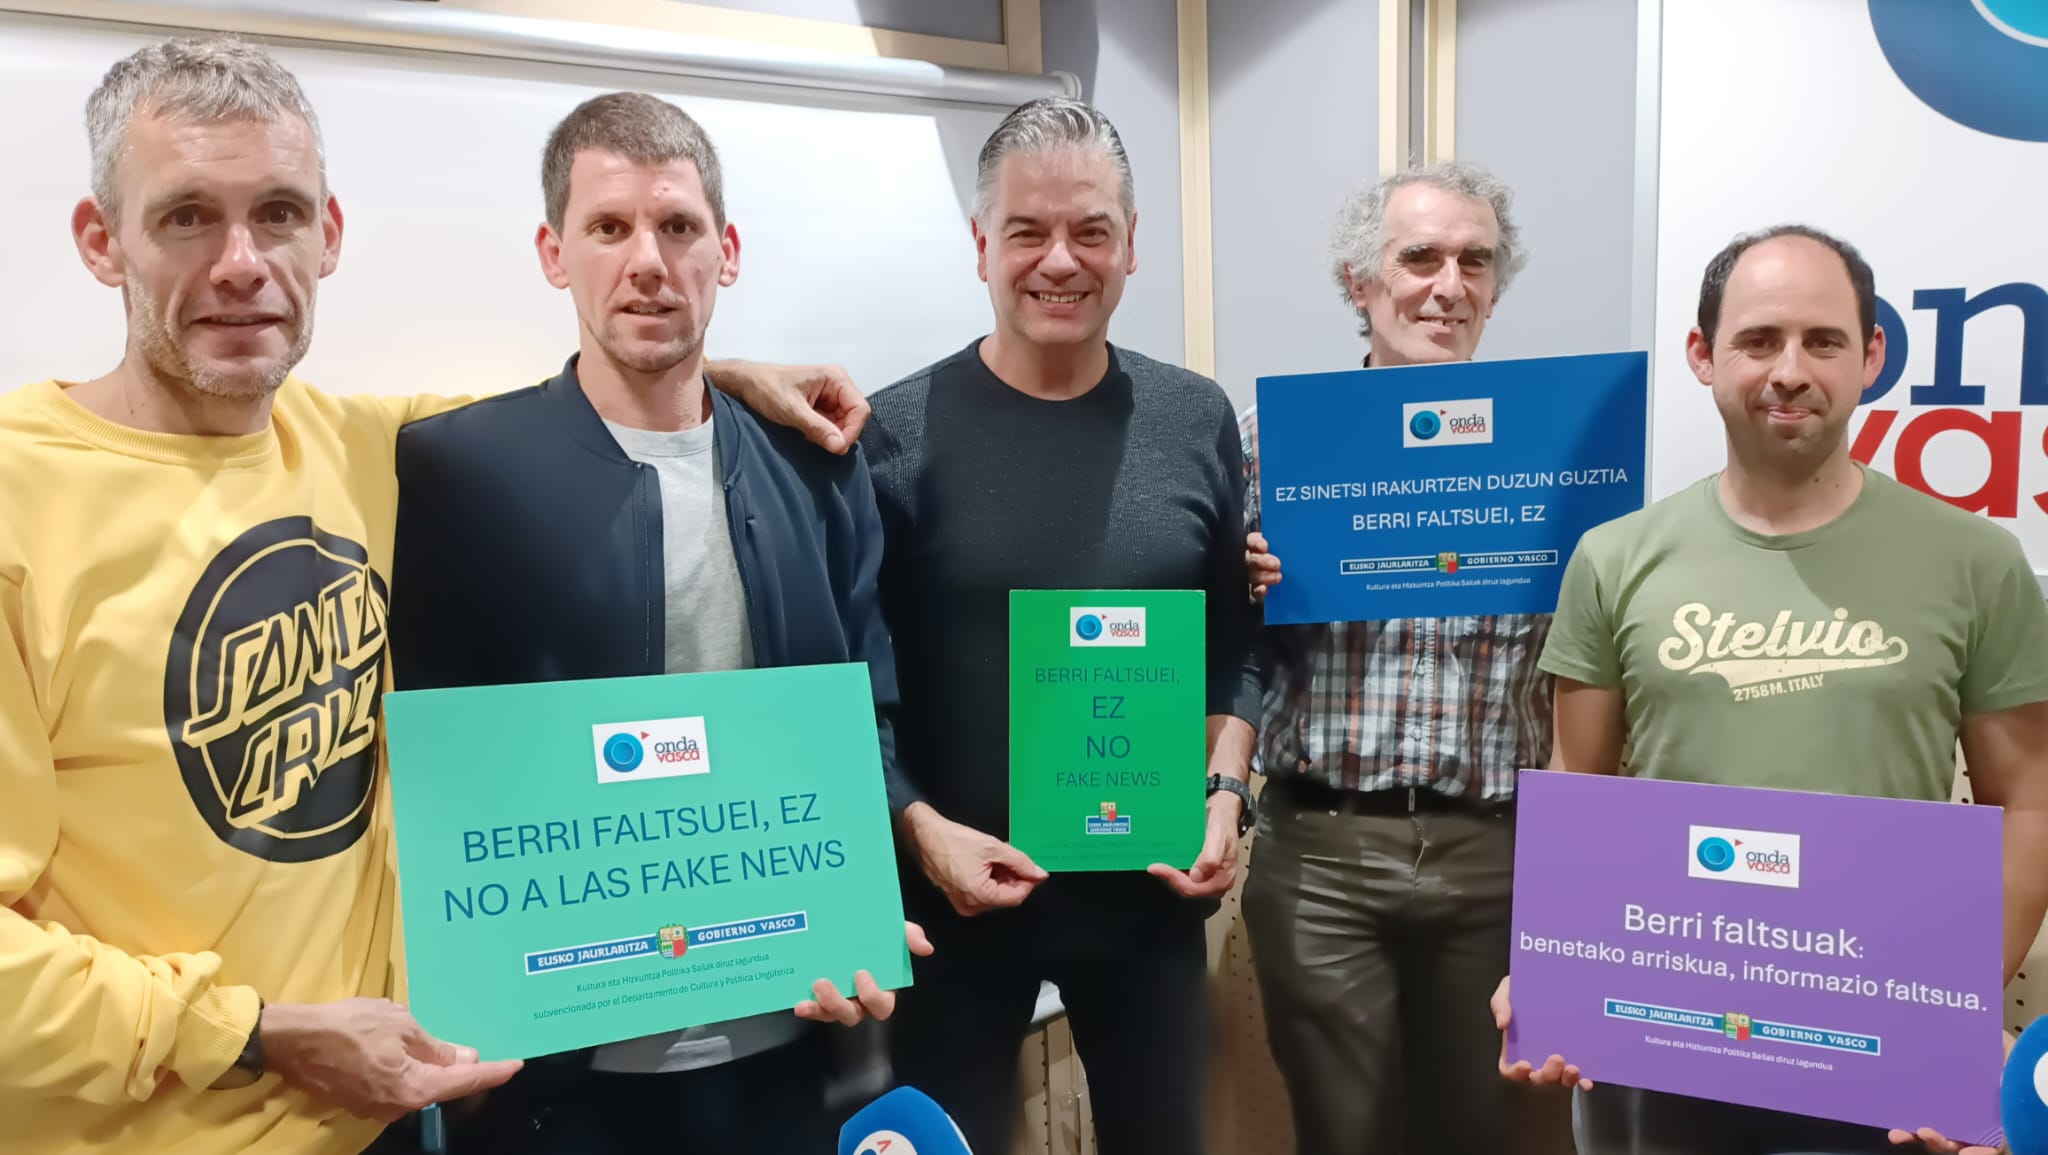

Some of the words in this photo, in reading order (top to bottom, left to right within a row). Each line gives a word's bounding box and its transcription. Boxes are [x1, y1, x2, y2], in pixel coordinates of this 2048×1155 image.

[1450, 413, 1485, 427] onda
[1451, 424, 1486, 434] vasca
[1276, 487, 1297, 502] EZ
[1300, 482, 1367, 500] SINETSI
[1372, 476, 1482, 496] IRAKURTZEN
[1487, 472, 1553, 490] DUZUN
[1559, 468, 1628, 486] GUZTIA
[1353, 512, 1411, 531] BERRI
[1417, 506, 1515, 527] FALTSUEI,
[1521, 505, 1546, 522] EZ
[1349, 562, 1375, 571] EUSKO
[1377, 559, 1429, 570] JAURLARITZA
[1467, 556, 1514, 565] GOBIERNO
[1518, 554, 1548, 563] VASCO
[1109, 619, 1139, 631] onda
[1110, 629, 1140, 637] vasca
[1657, 602, 1895, 671] Stelvio
[1035, 667, 1088, 683] BERRI
[1093, 667, 1181, 685] FALTSUEI,
[1789, 674, 1824, 693] ITALY
[1092, 696, 1125, 719] EZ
[654, 736, 698, 754] onda
[656, 748, 700, 764] vasca
[1086, 735, 1130, 759] NO
[1056, 772, 1100, 787] FAKE
[1106, 771, 1160, 787] NEWS
[463, 819, 581, 863] BERRI
[593, 800, 770, 848] FALTSUEI,
[780, 793, 821, 825] EZ
[1745, 850, 1789, 864] onda
[1747, 861, 1791, 875] vasca
[444, 883, 510, 922] NO
[521, 878, 549, 912] A
[558, 867, 631, 906] LAS
[641, 853, 732, 895] FAKE
[740, 840, 846, 881] NEWS
[537, 953, 574, 967] EUSKO
[577, 941, 649, 963] JAURLARITZA
[697, 924, 756, 942] GOBIERNO
[760, 918, 796, 931] VASCO
[1624, 903, 1702, 940] Berri
[1712, 914, 1864, 959] faltsuak:
[576, 979, 606, 993] Kultura
[607, 979, 621, 988] eta
[661, 966, 691, 978] Politika
[735, 952, 770, 967] lagundua
[1520, 931, 1625, 963] benetako
[1631, 950, 1735, 981] arriskua,
[1743, 960, 1878, 997] informazio
[1885, 978, 1988, 1012] faltsua.
[533, 1000, 597, 1021] subvencionada
[597, 998, 611, 1011] por
[612, 995, 621, 1005] el
[621, 987, 678, 1006] Departamento
[678, 984, 689, 994] de
[690, 979, 719, 992] Cultura
[1615, 1004, 1646, 1017] EUSKO
[1649, 1009, 1714, 1027] JAURLARITZA
[1762, 1025, 1823, 1042] GOBIERNO
[1828, 1035, 1867, 1049] VASCO
[1645, 1035, 1671, 1047] Kultura
[1672, 1040, 1684, 1048] eta
[1685, 1041, 1721, 1054] Hizkuntza
[1723, 1047, 1750, 1059] Politika
[1776, 1055, 1795, 1065] diruz
[1796, 1057, 1833, 1071] lagundua
